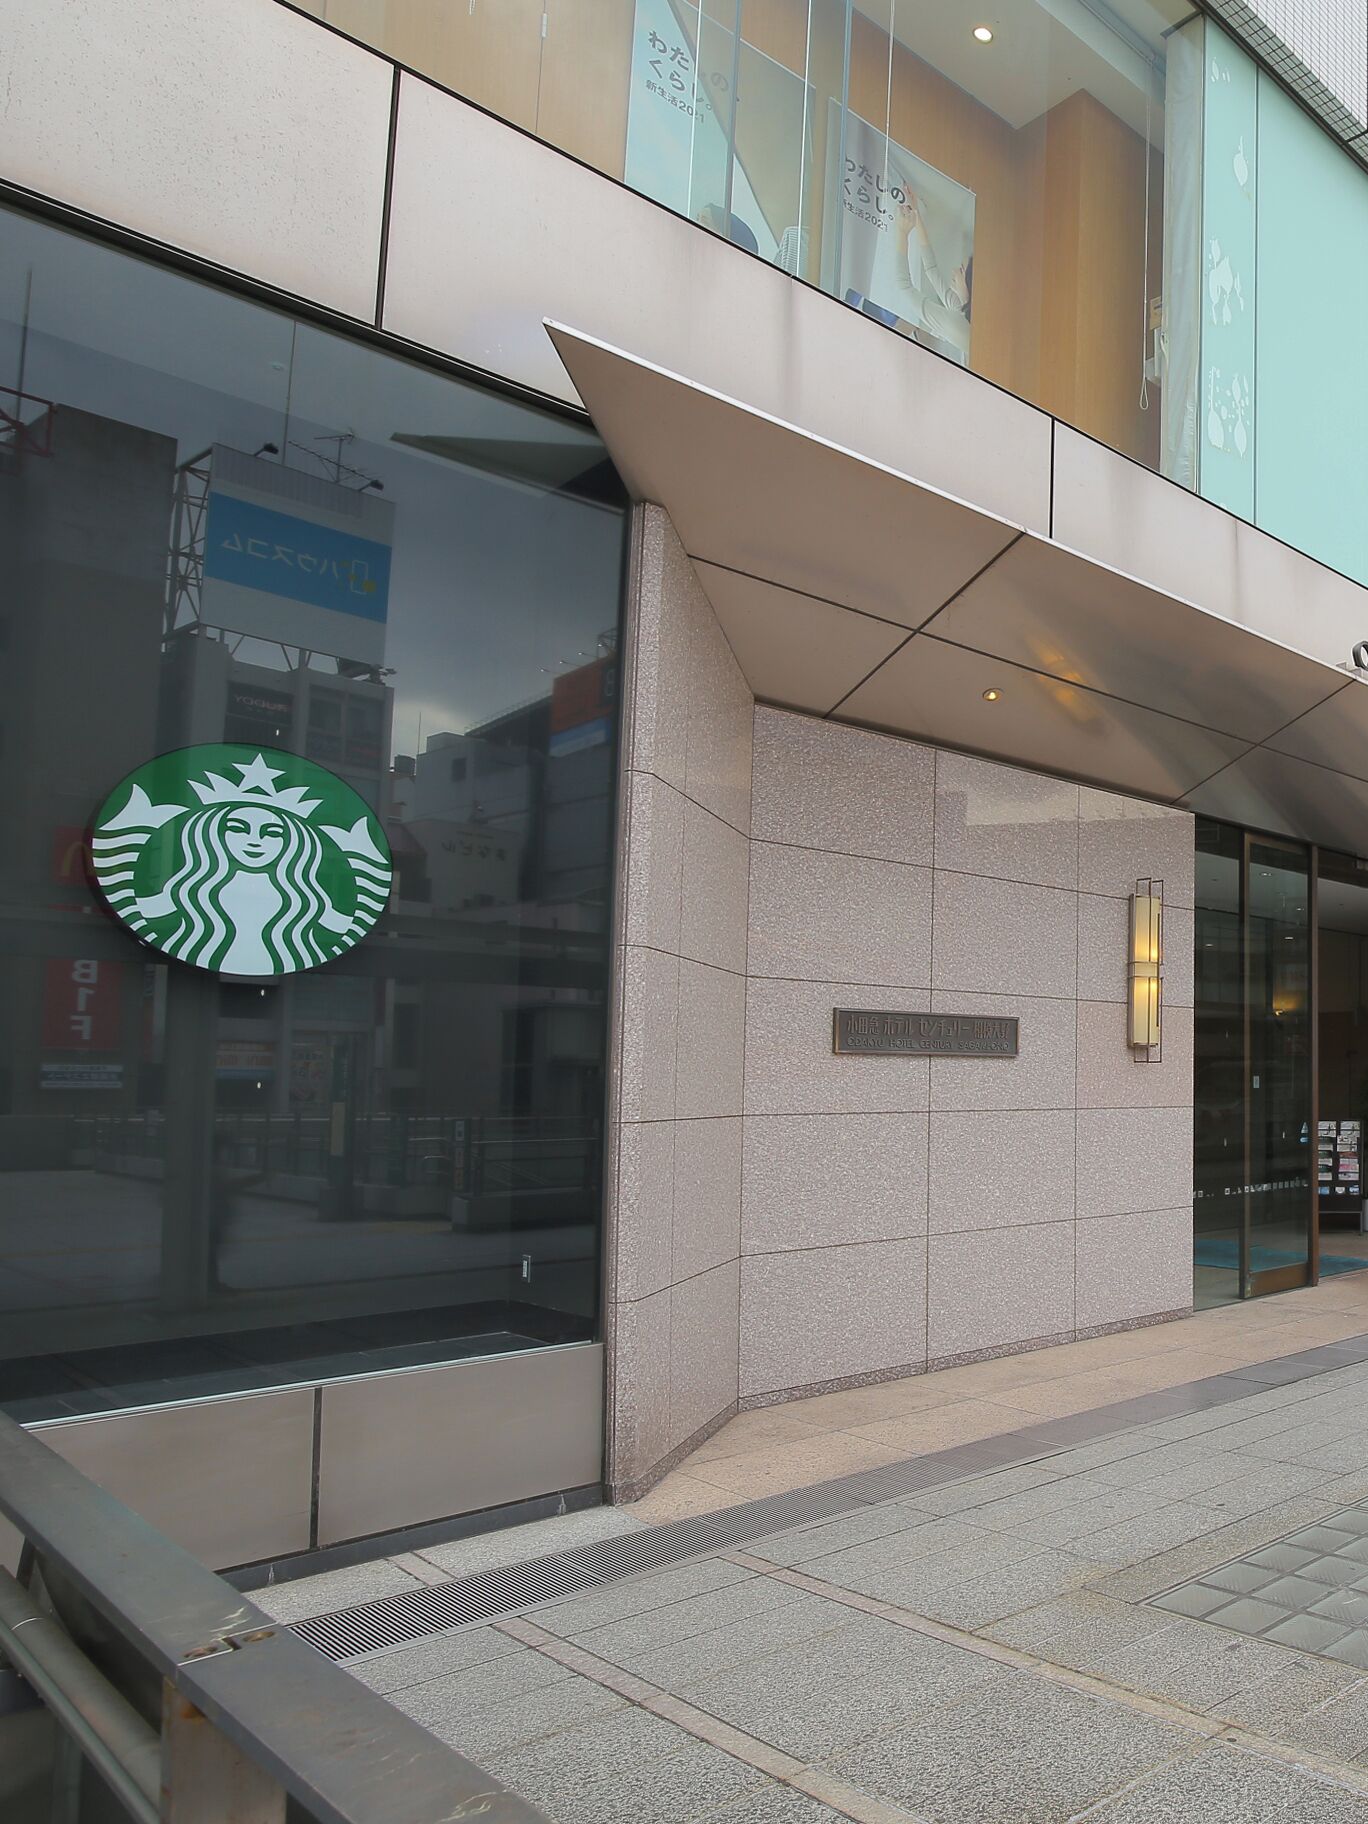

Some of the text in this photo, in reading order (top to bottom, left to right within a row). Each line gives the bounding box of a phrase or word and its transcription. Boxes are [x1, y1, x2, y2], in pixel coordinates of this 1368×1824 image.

[847, 1015, 880, 1035] 小田急
[883, 1017, 914, 1037] ホテル
[917, 1018, 970, 1038] センチュリー
